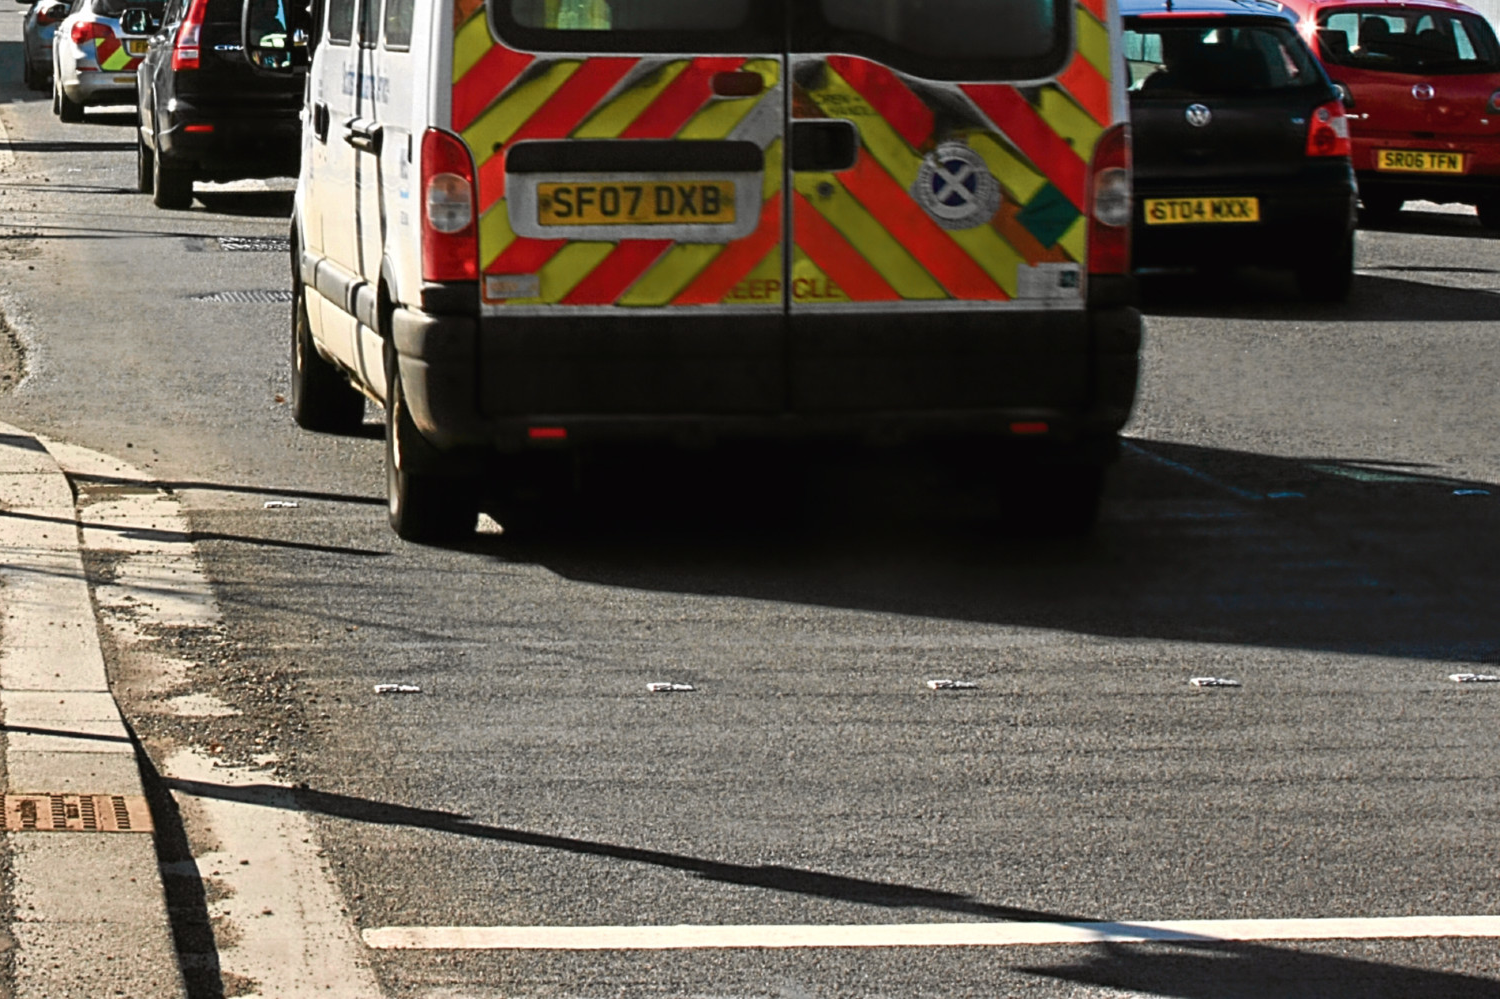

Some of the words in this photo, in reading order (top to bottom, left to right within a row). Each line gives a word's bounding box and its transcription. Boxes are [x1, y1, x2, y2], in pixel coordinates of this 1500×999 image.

[1384, 153, 1423, 170] SR06
[1428, 153, 1459, 170] TFN
[552, 186, 644, 218] SF07
[655, 185, 721, 216] DXB
[728, 279, 781, 299] EEP
